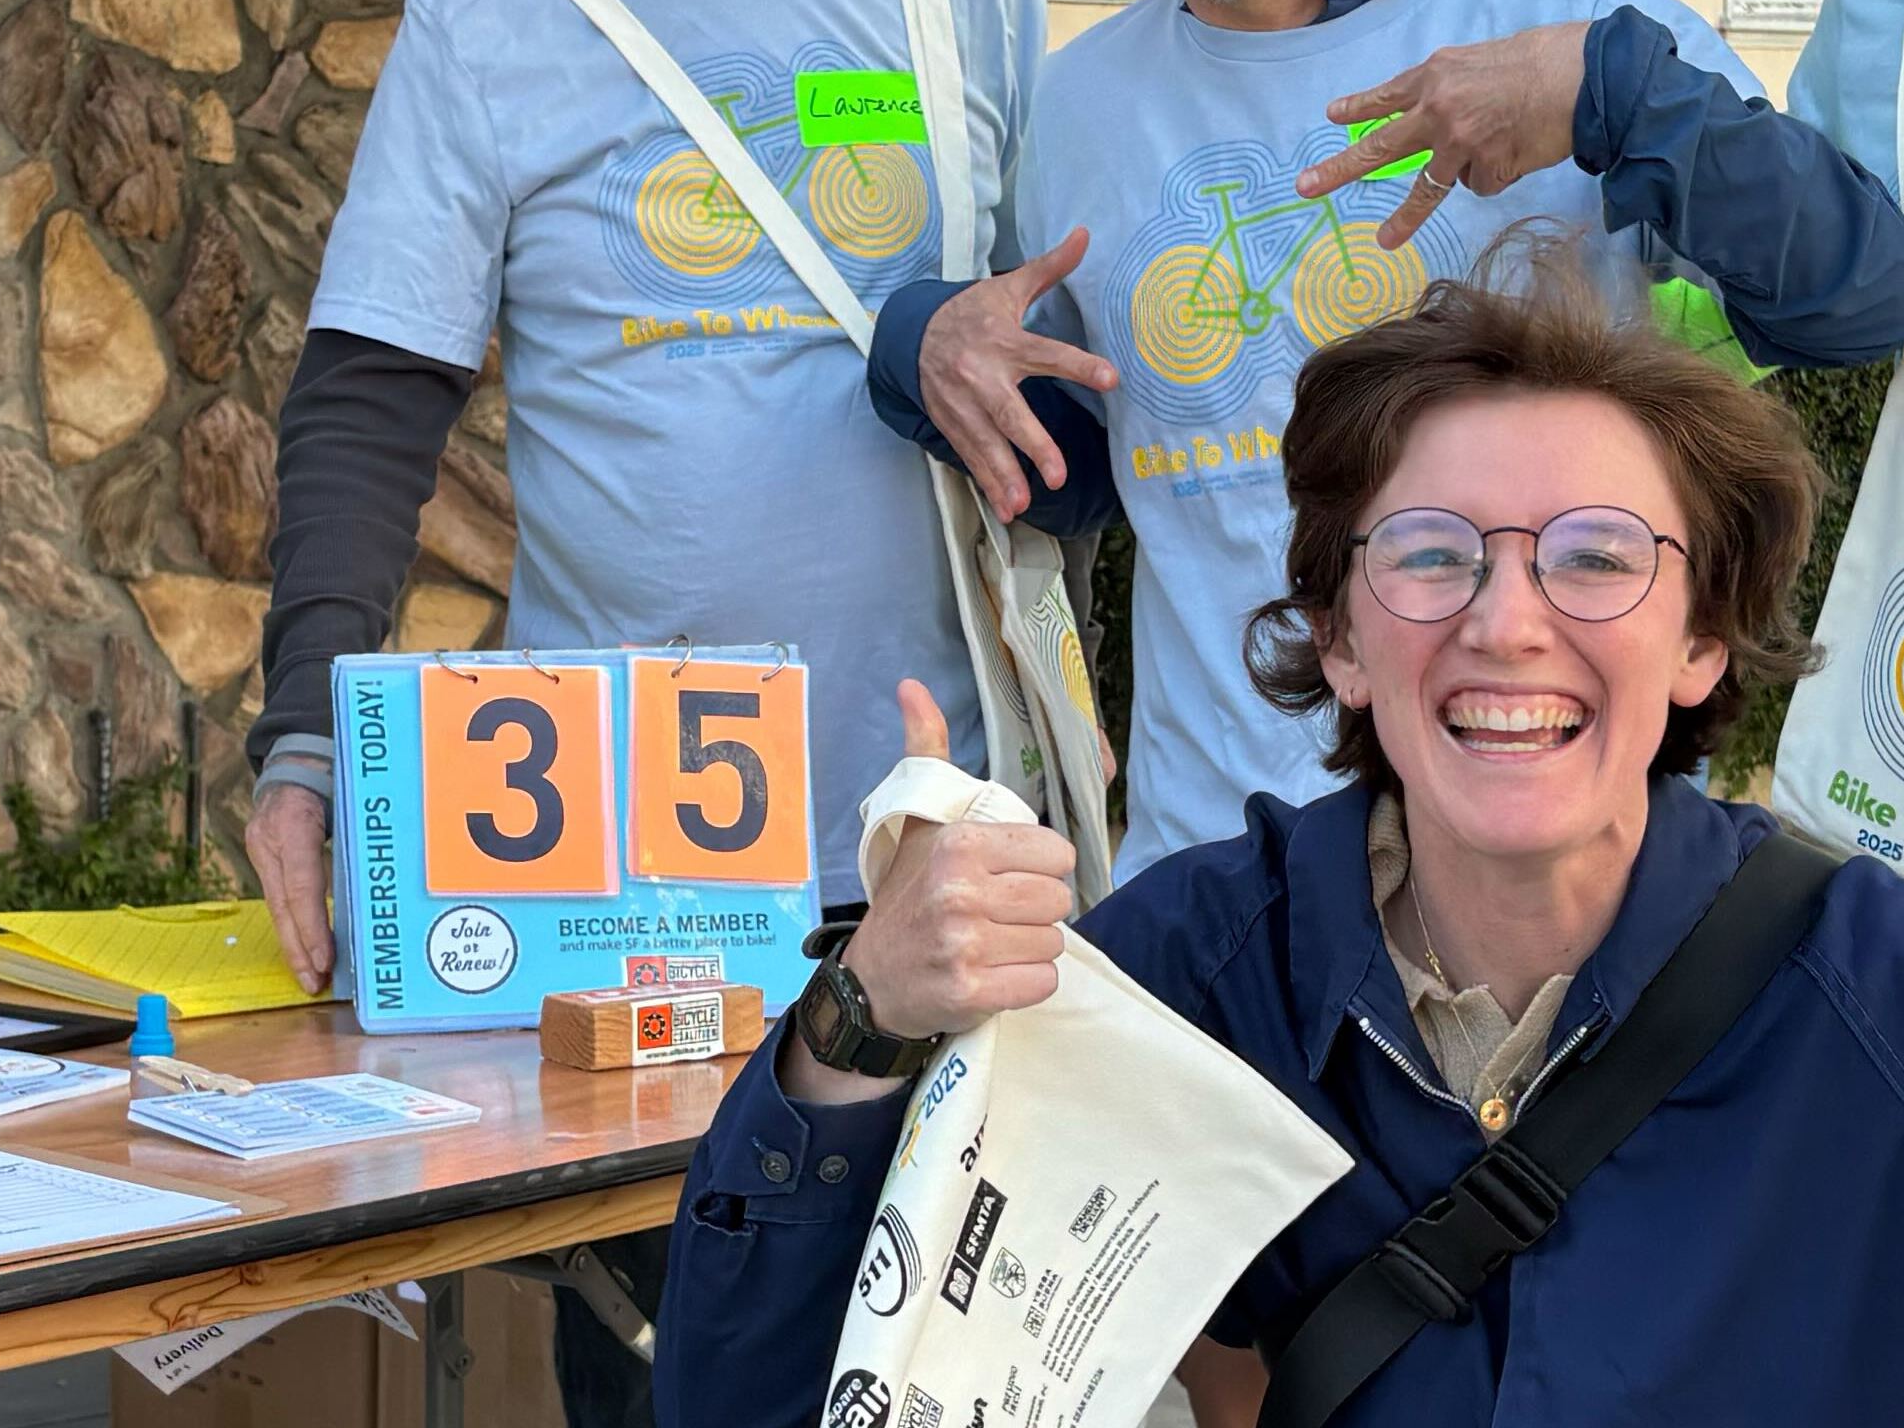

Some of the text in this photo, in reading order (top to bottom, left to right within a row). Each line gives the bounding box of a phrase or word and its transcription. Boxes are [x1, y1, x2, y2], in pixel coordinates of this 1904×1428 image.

[810, 88, 923, 117] Lawrence
[622, 315, 687, 347] Bike
[694, 309, 733, 337] To
[665, 343, 705, 360] 2025
[1191, 436, 1224, 468] To
[465, 689, 769, 863] 3 5
[1827, 770, 1896, 828] Bike
[355, 678, 406, 1010] MEMBERSHIPS TODAY!
[1857, 829, 1904, 862] 2025
[451, 917, 493, 938] Join
[559, 913, 770, 937] BECOME A MEMBER
[440, 948, 509, 972] Renew!
[560, 934, 778, 952] and make SF a better place to bike!
[668, 963, 718, 980] BICYCLE
[922, 1052, 968, 1120] 2025
[1127, 1178, 1159, 1215] Authority
[966, 1194, 997, 1258] SFMTA
[859, 1247, 892, 1298] 511
[153, 1324, 225, 1370] Delivery
